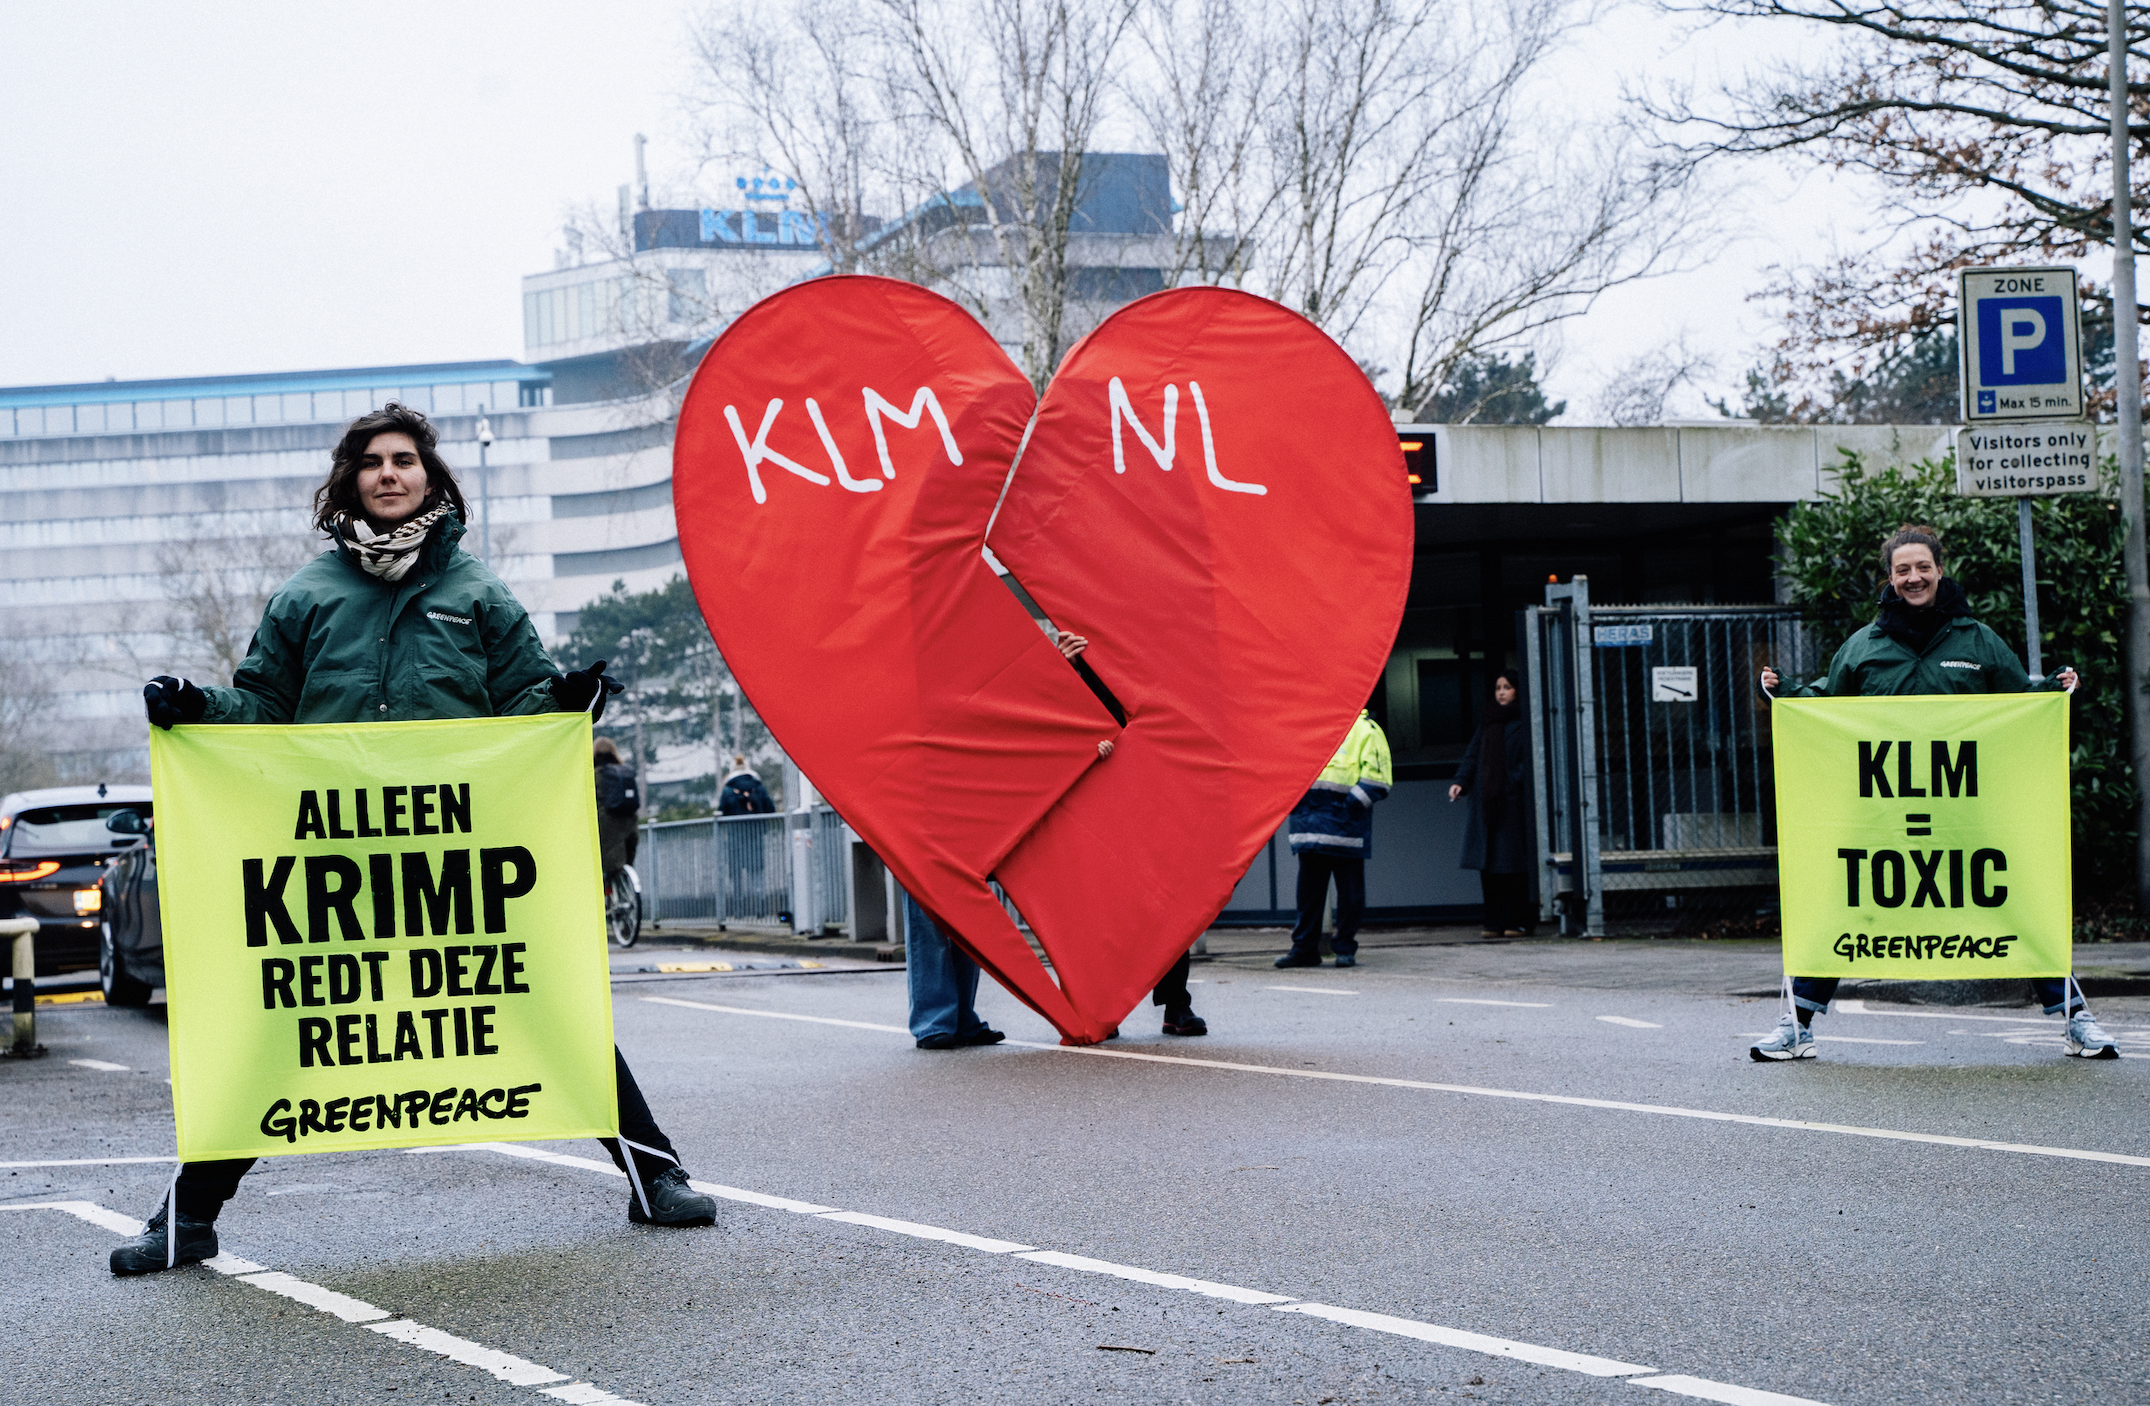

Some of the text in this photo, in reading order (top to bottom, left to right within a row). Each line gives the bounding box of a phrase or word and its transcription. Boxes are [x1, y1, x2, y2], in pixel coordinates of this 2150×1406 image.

[1994, 278, 2045, 293] ZONE
[2000, 308, 2047, 375] P
[2000, 396, 2072, 409] Max 15 min.
[724, 387, 963, 504] KLM
[1109, 377, 1267, 495] NL
[1968, 453, 2090, 471] for collecting
[1970, 432, 2086, 450] Visitors only
[1975, 474, 2086, 490] visitorspass
[426, 611, 473, 625] GREENPEACE
[1597, 627, 1650, 640] HERAS
[1858, 741, 1978, 798] KLM
[295, 783, 471, 839] ALLEEN
[1906, 814, 1931, 836] =
[243, 846, 536, 948] KRIMP
[1838, 848, 2007, 908] TOXIC
[1834, 933, 2017, 962] GREENPEACE
[262, 943, 529, 1009] REDT DEZE
[299, 1006, 498, 1067] RELATIE
[260, 1083, 541, 1143] GREENPEACE
